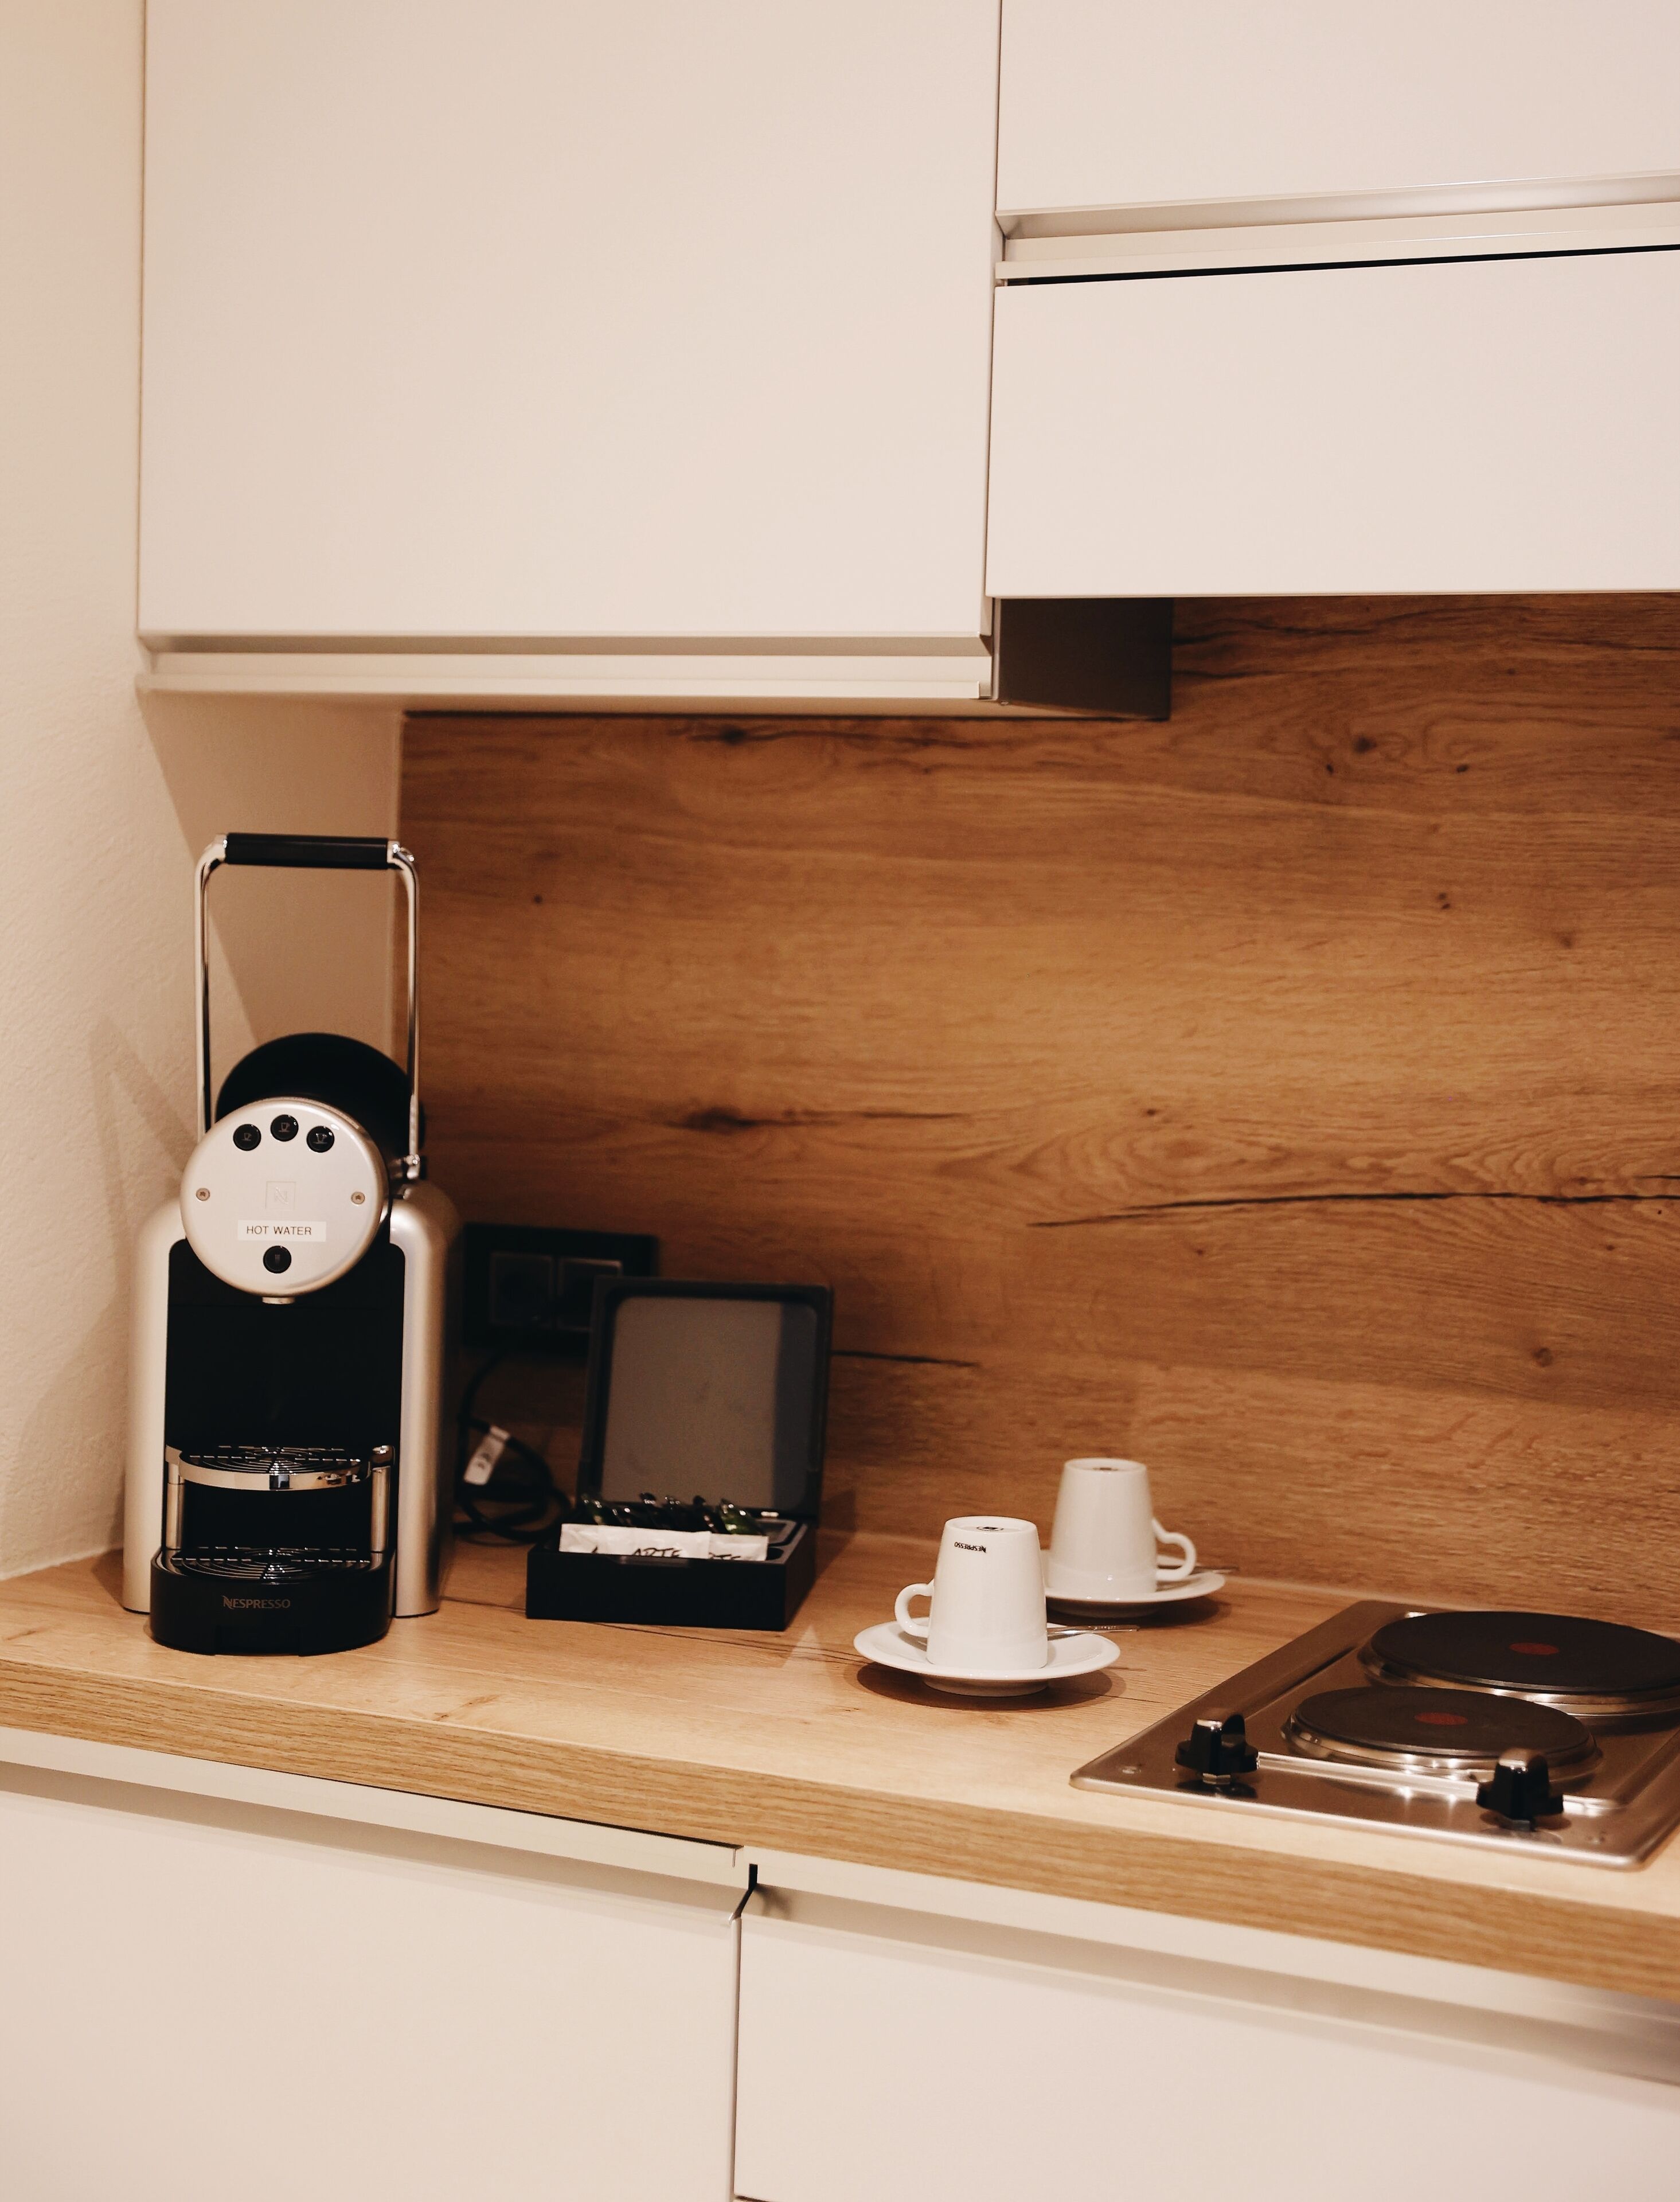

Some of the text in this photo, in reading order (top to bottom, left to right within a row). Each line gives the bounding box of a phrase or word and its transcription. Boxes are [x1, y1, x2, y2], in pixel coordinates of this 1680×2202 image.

[246, 1225, 312, 1235] HOT WATER
[954, 1541, 986, 1553] NESPRESSO
[221, 1595, 291, 1610] NESPRESSO
